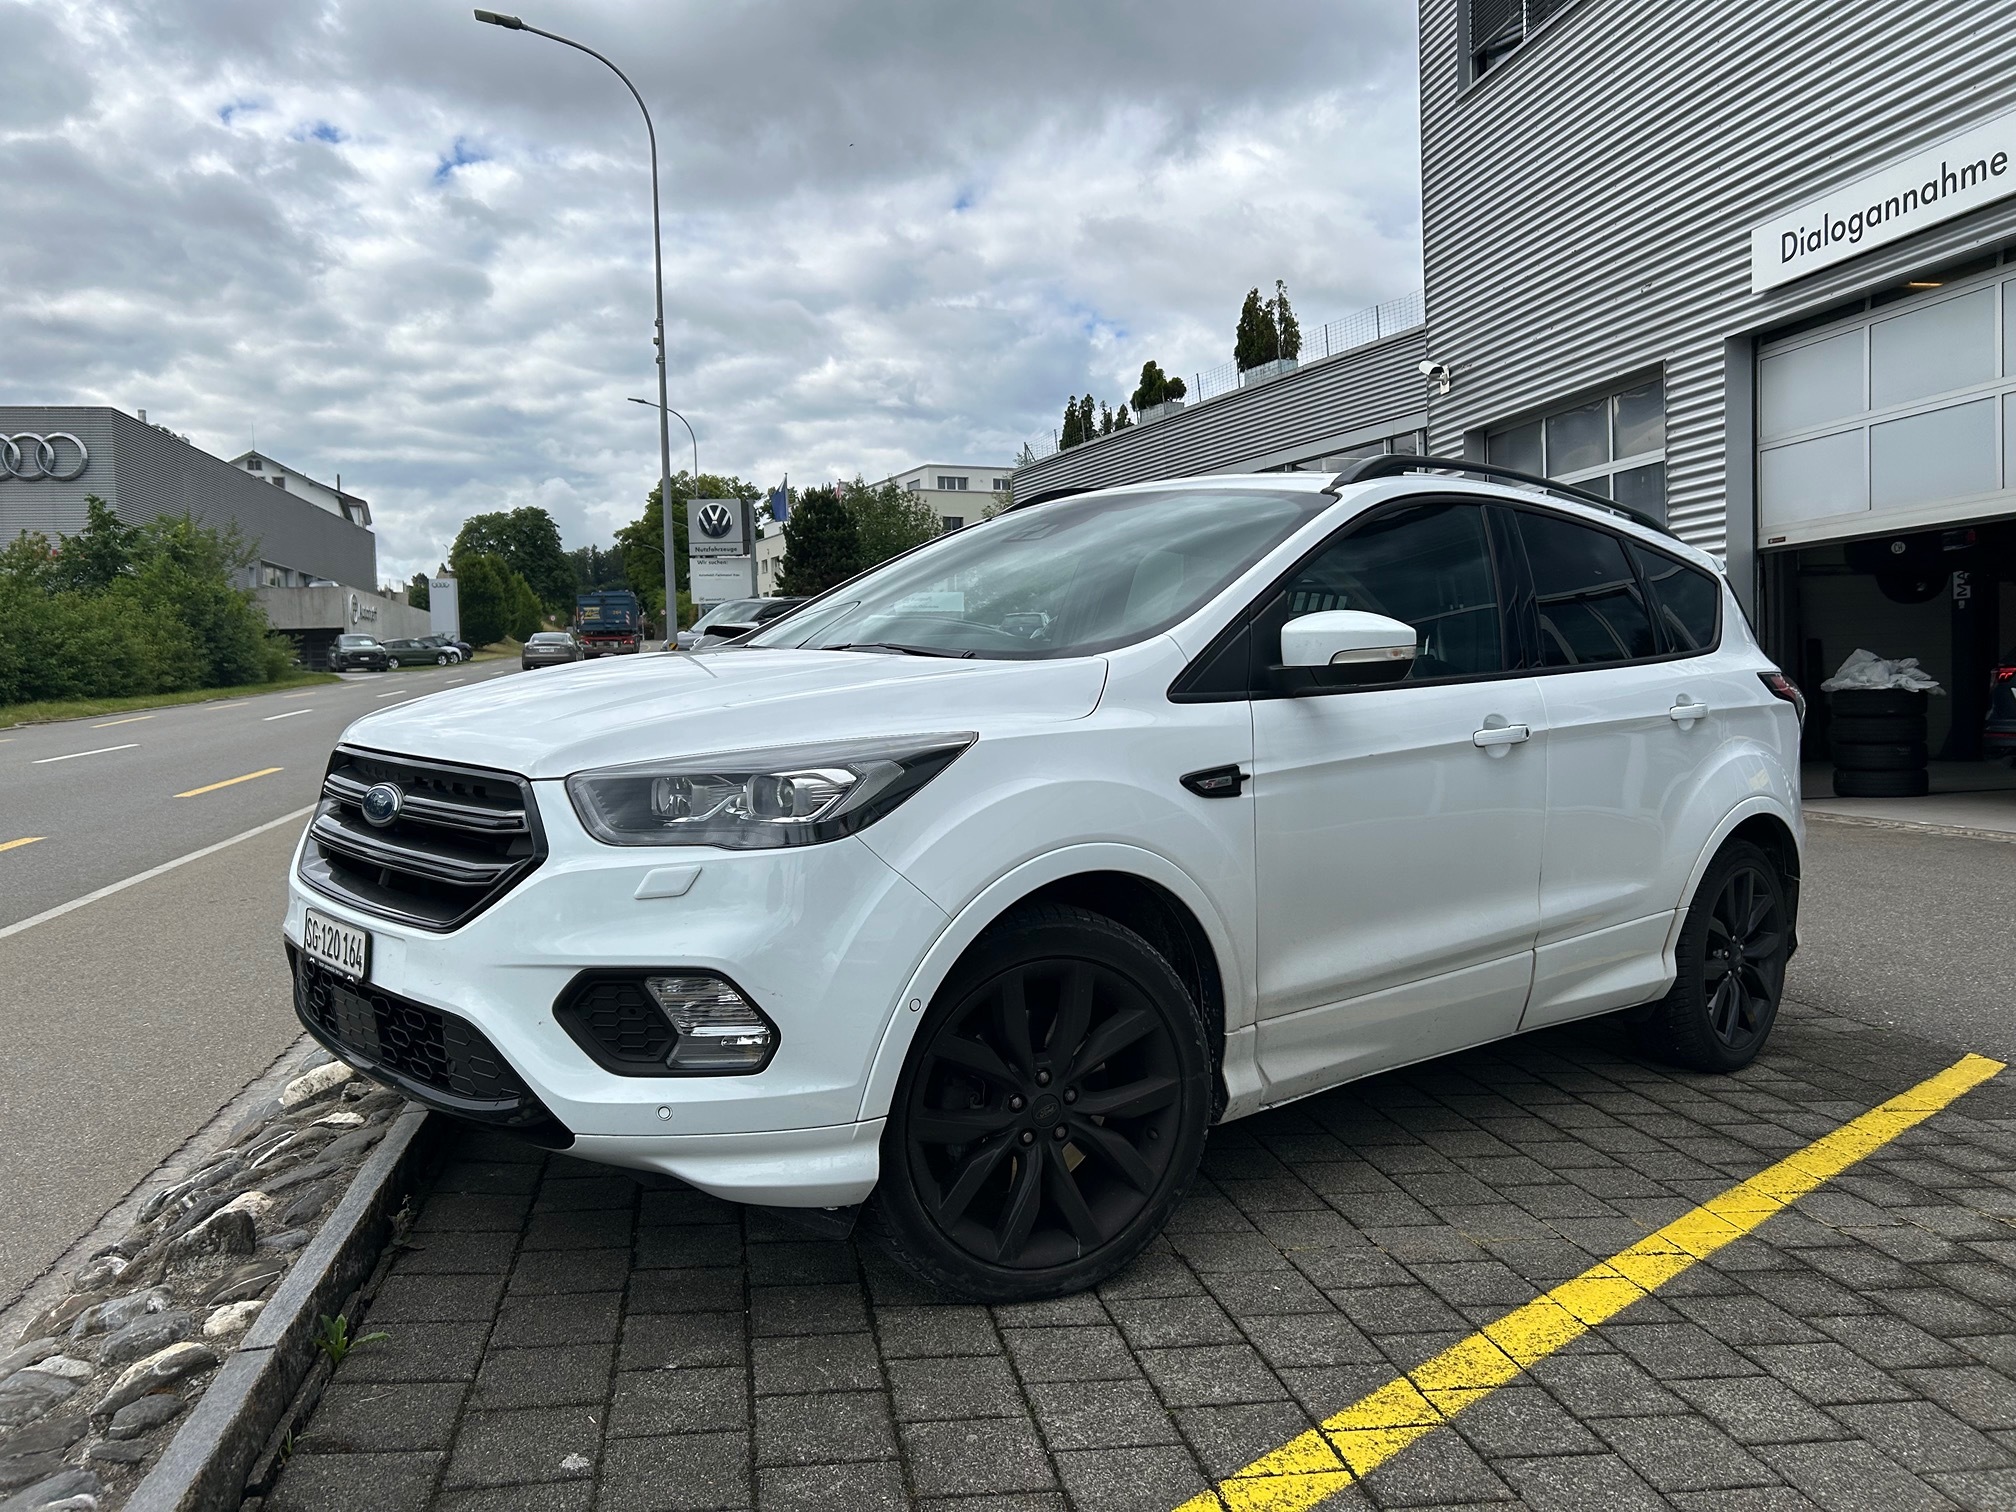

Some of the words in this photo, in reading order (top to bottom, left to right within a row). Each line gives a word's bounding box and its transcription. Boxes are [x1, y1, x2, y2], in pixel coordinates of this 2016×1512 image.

[1780, 150, 2009, 264] Dialogannahme
[694, 545, 738, 554] Nutzfahrzeuge
[342, 932, 363, 972] 164
